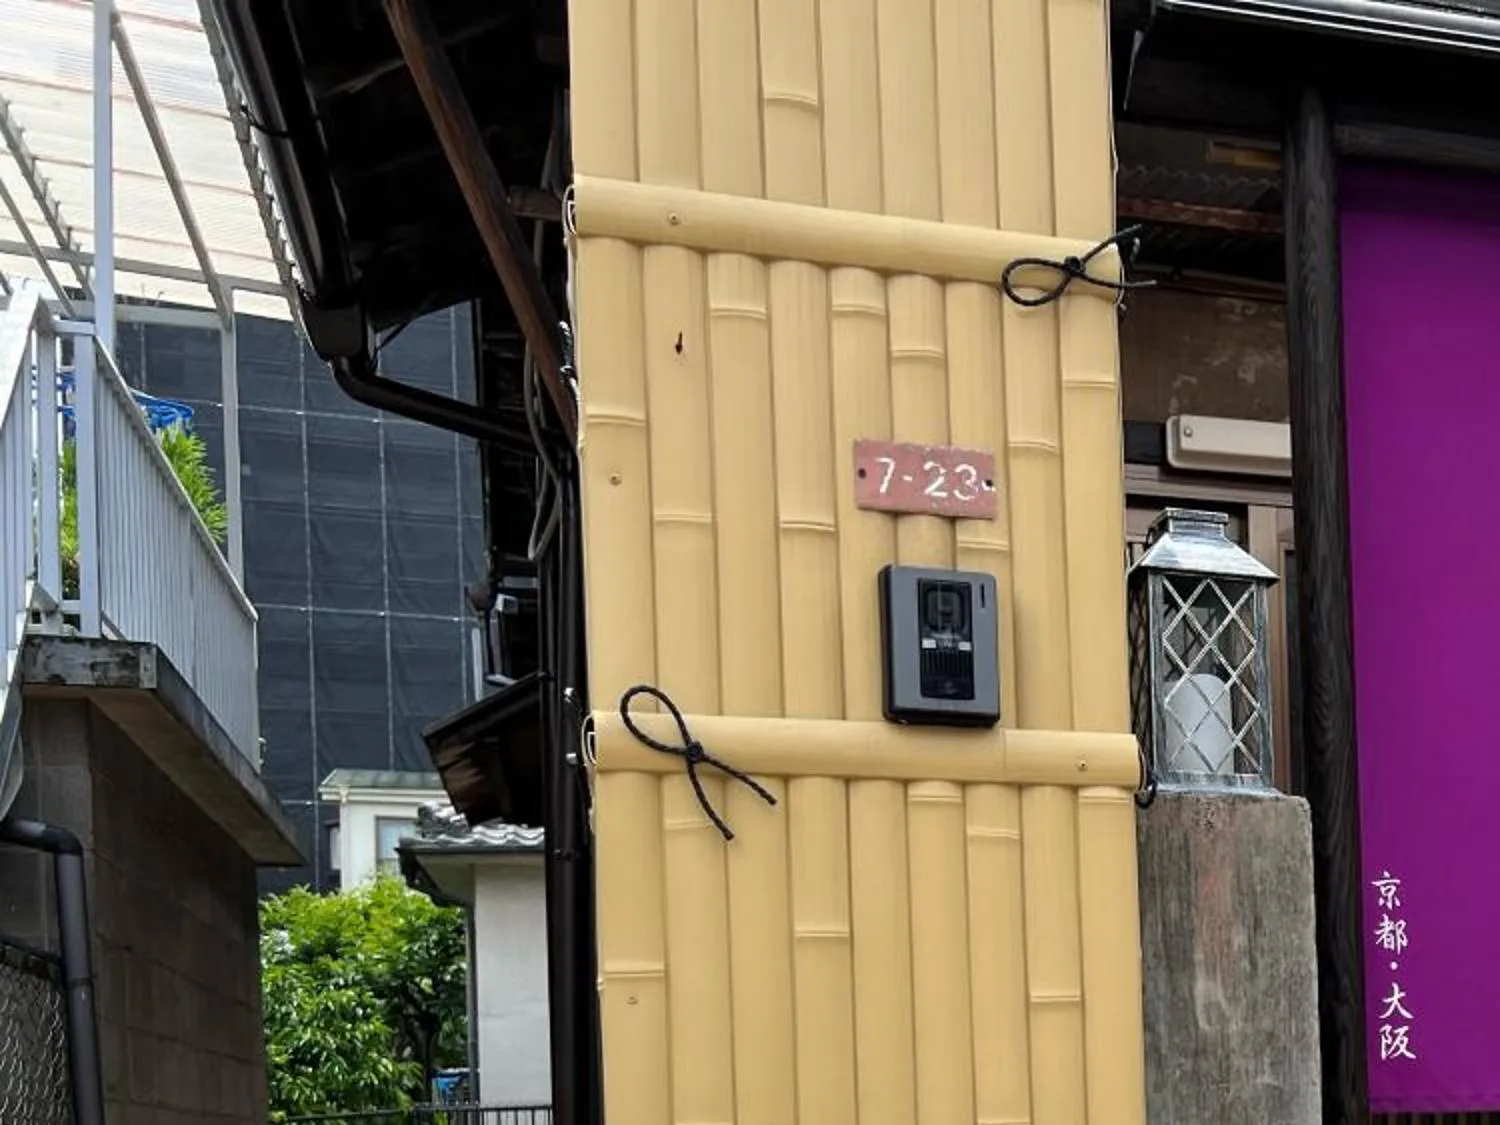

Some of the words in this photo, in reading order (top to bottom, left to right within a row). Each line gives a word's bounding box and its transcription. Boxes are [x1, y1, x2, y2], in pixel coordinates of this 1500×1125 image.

[875, 456, 978, 501] 7-23
[1370, 870, 1418, 1061] 京都・大阪
